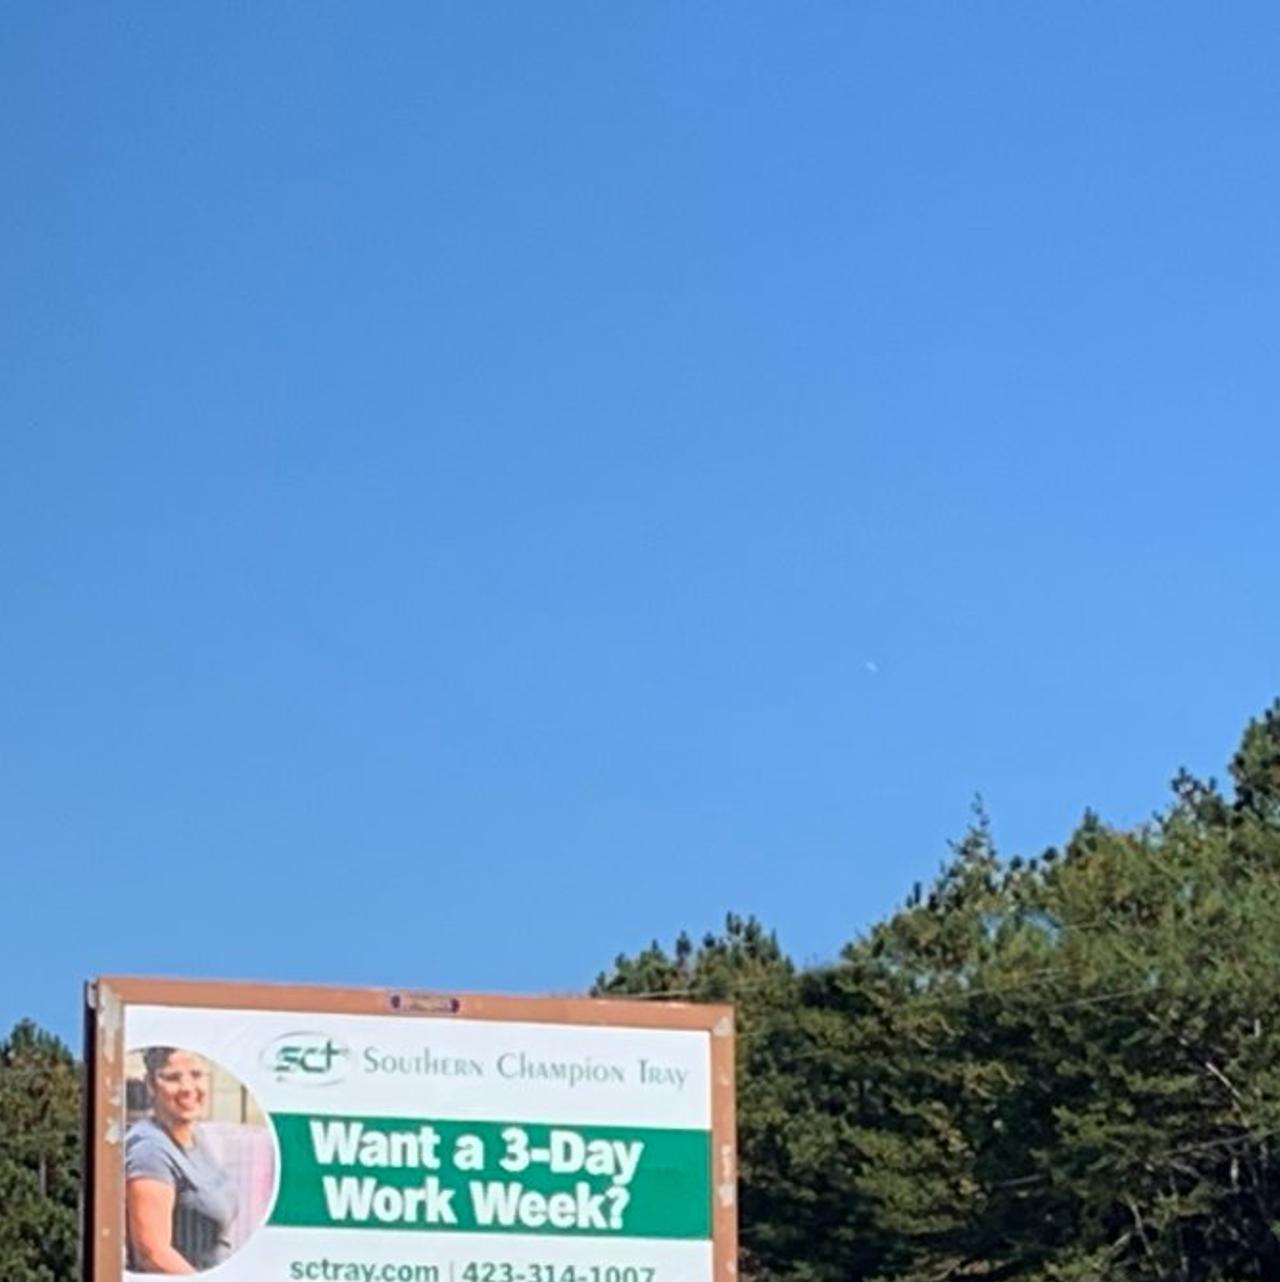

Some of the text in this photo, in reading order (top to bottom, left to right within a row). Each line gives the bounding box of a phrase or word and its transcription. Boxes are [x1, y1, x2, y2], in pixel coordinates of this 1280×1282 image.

[309, 1119, 645, 1185] Want a 3-Day
[322, 1175, 632, 1232] Work Week?
